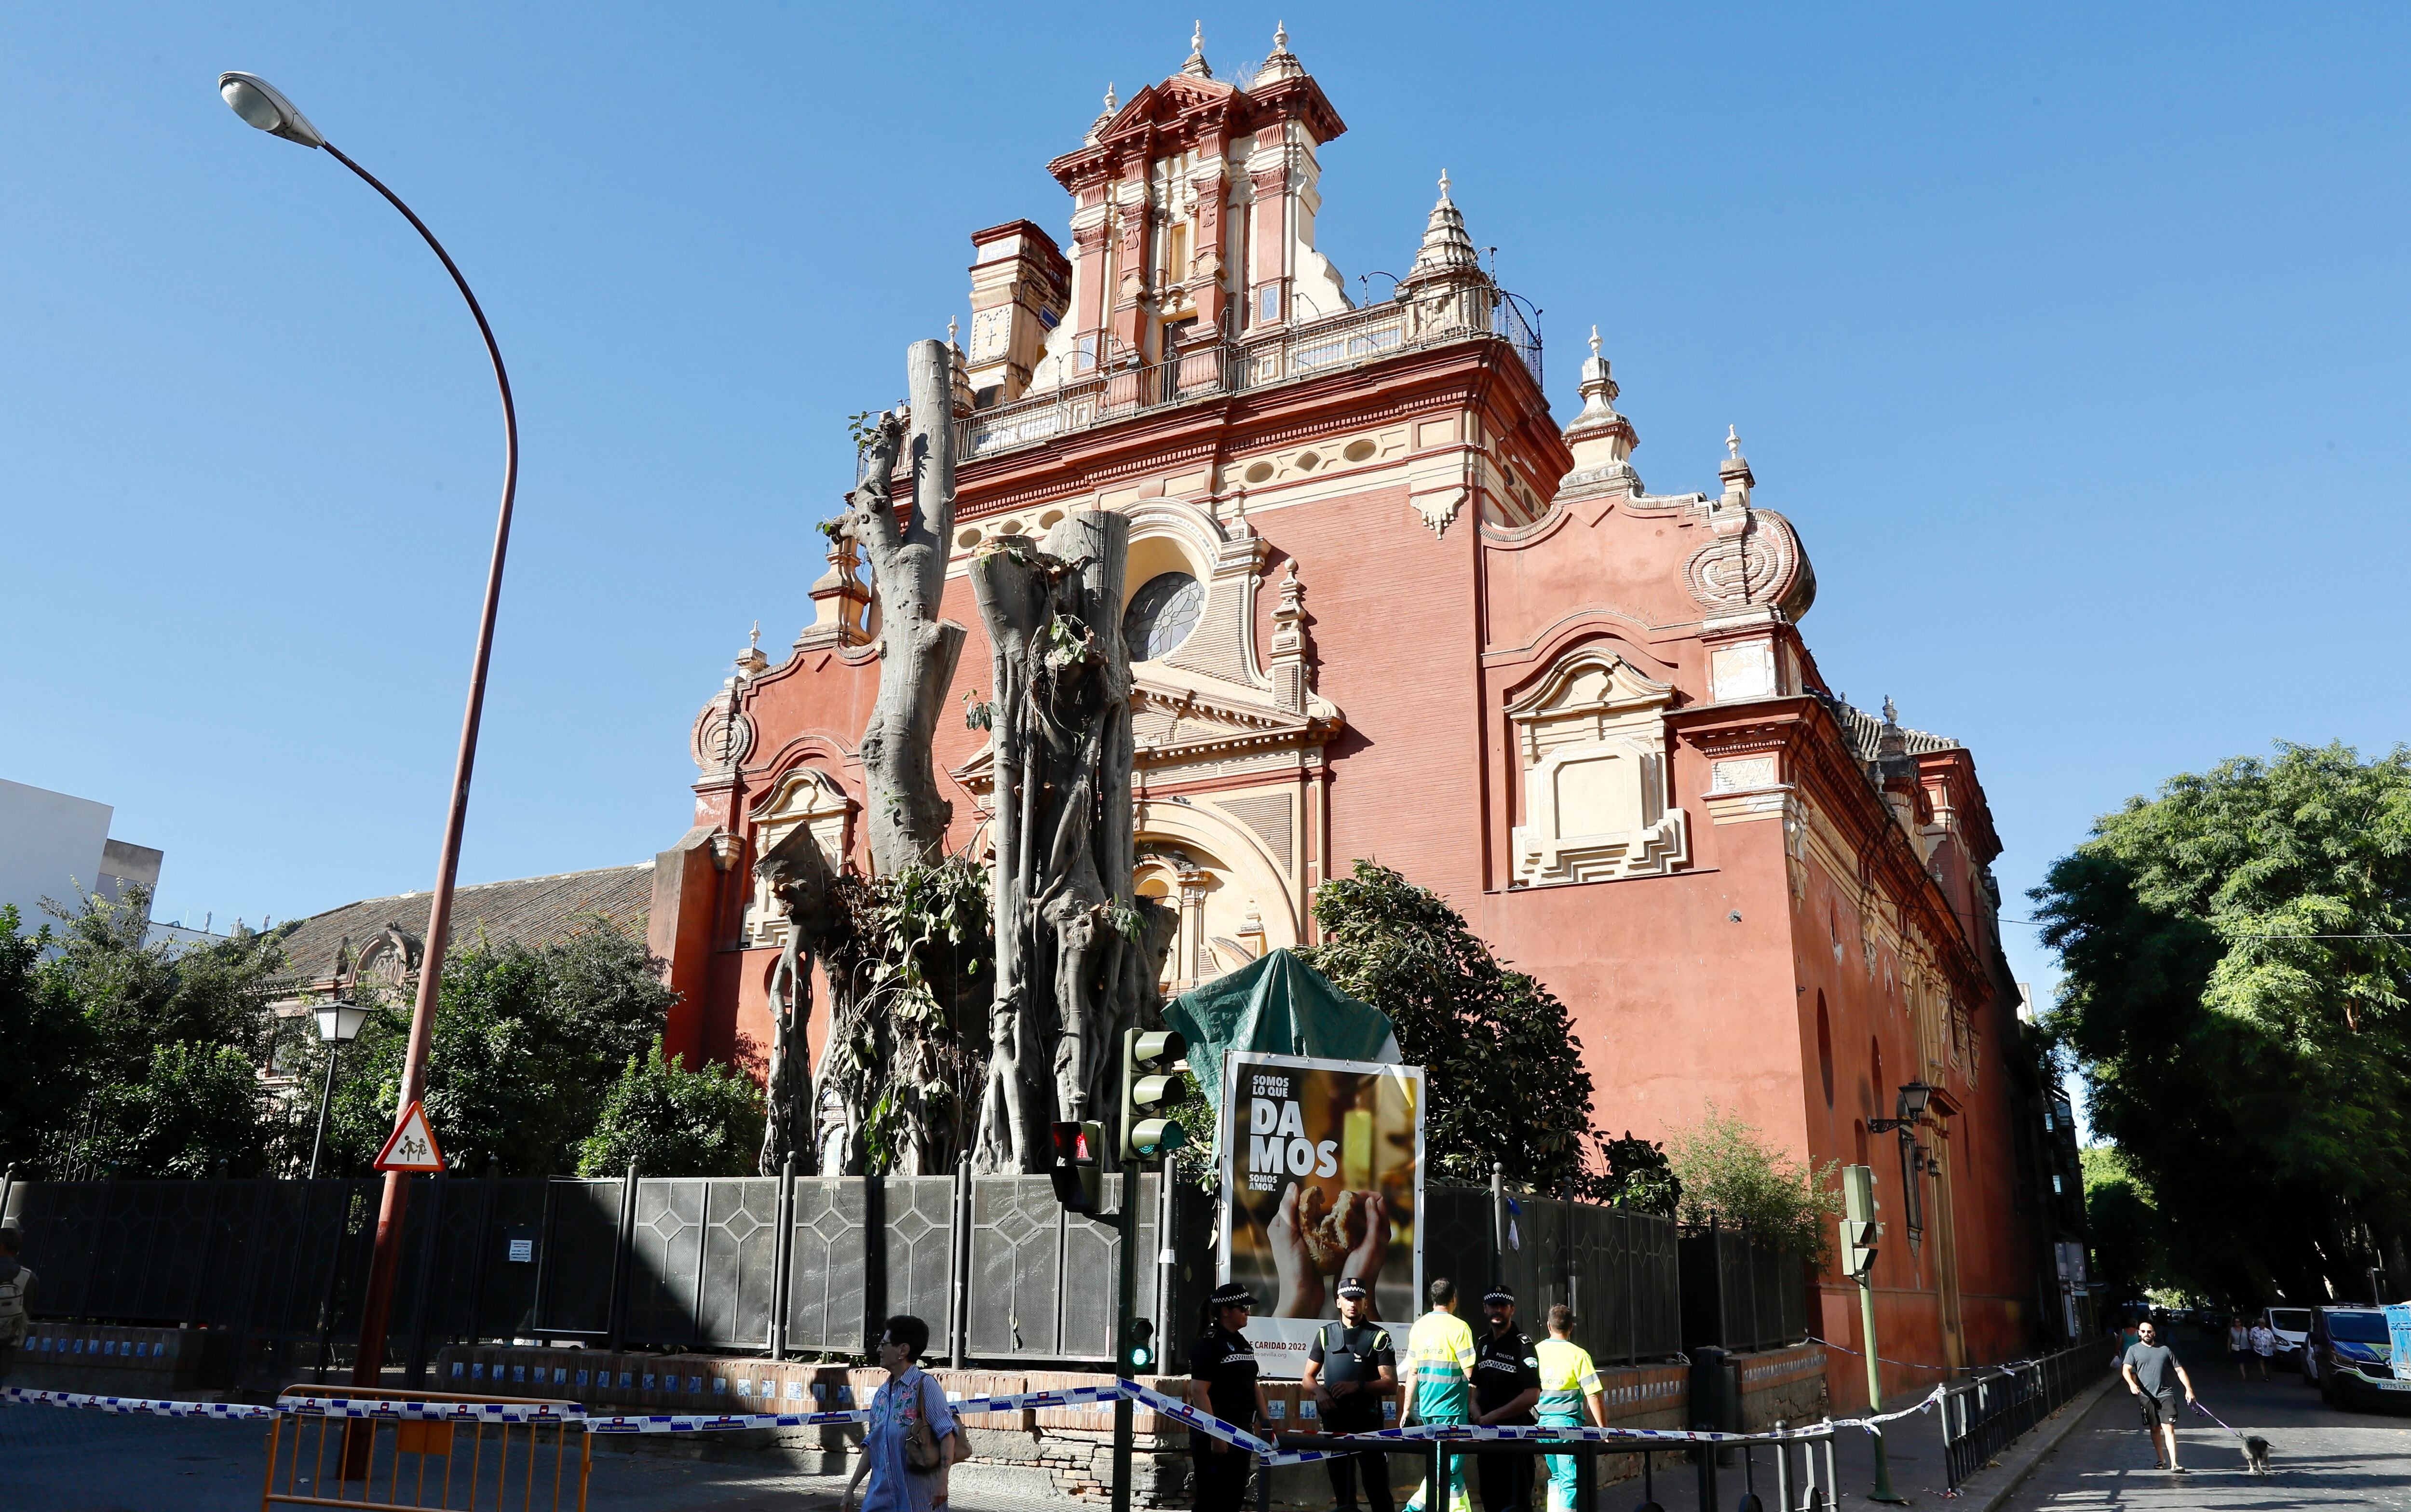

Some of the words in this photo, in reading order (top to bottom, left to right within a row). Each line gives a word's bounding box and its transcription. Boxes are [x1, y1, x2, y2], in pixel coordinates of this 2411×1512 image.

[1253, 1075, 1289, 1087] SOMOS
[1252, 1085, 1265, 1095] LO
[1267, 1086, 1288, 1097] QUE
[1250, 1098, 1305, 1138] DA
[1249, 1135, 1338, 1178] MOS
[1249, 1174, 1277, 1184] SOMOS
[1248, 1182, 1276, 1191] AMOR.
[1255, 1341, 1287, 1350] CARIDAD
[1288, 1342, 1306, 1350] 2022
[1496, 1352, 1514, 1361] POLICIA
